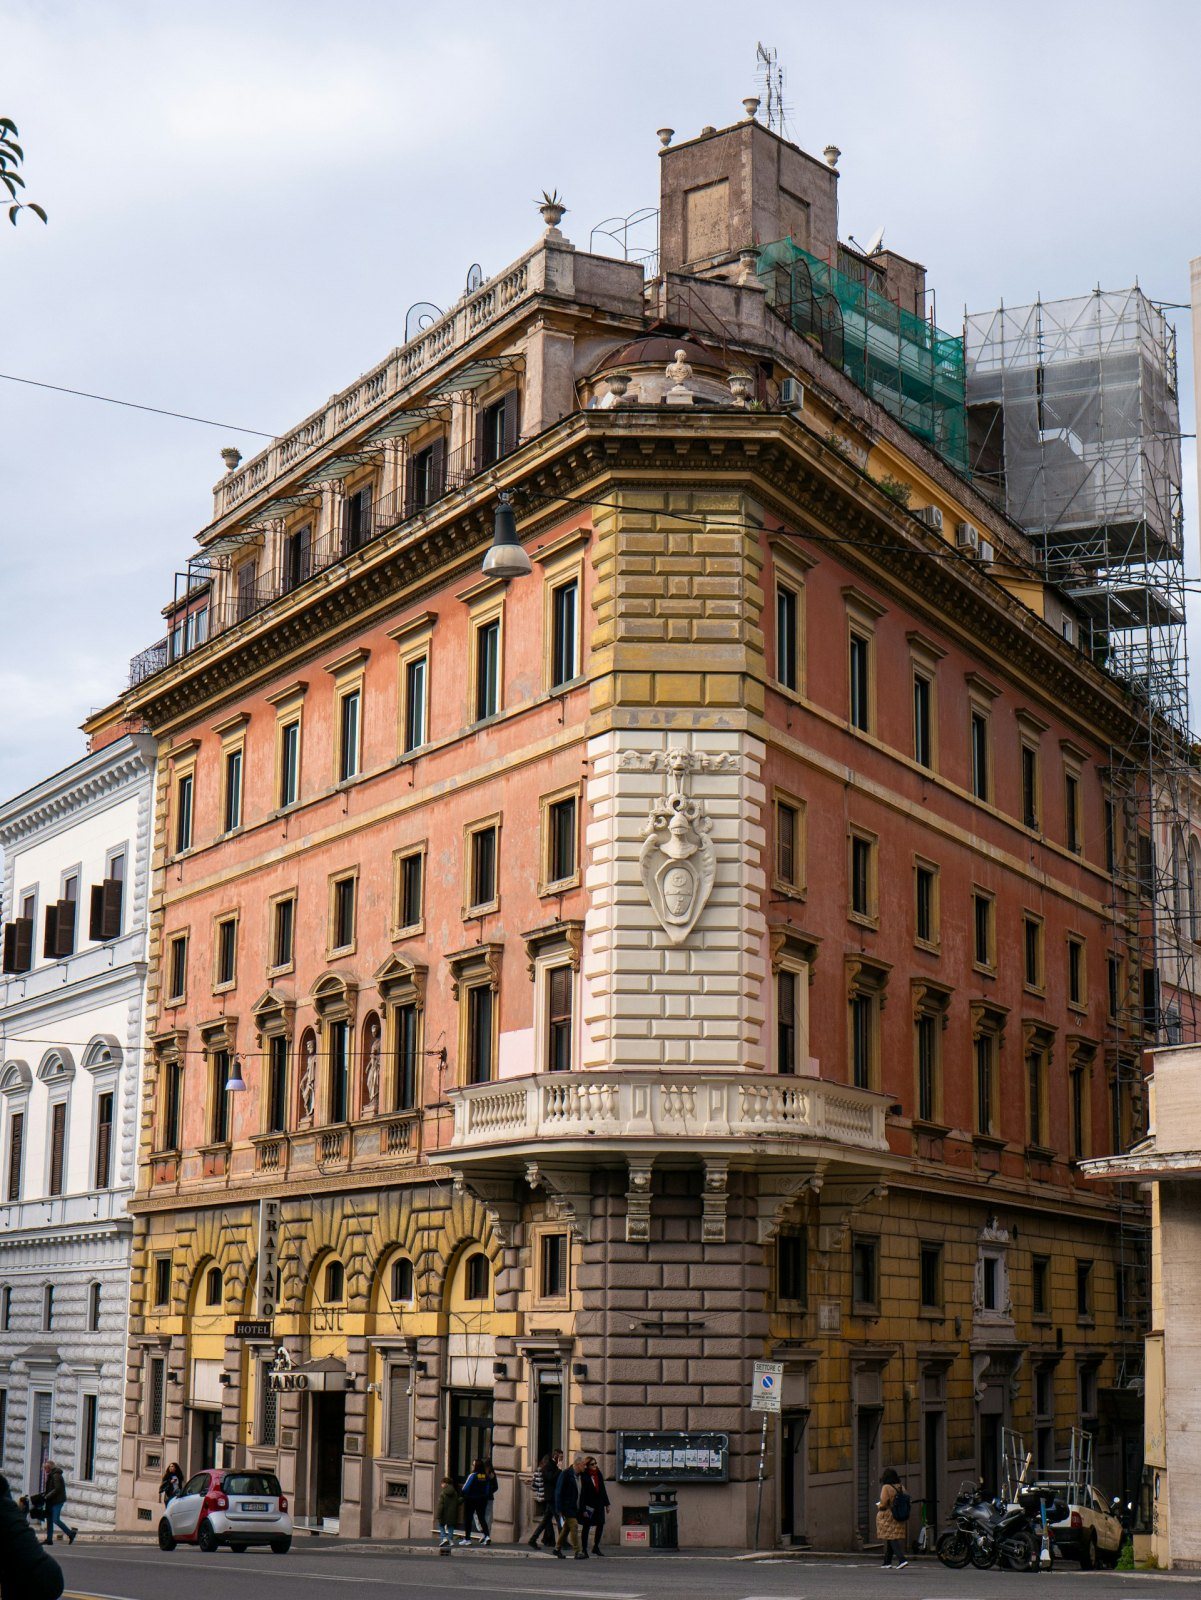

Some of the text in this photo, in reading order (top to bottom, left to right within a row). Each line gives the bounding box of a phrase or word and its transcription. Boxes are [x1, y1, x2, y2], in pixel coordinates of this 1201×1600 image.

[262, 1203, 277, 1317] TRAIANO
[237, 1325, 269, 1335] HOTEL
[756, 1363, 776, 1372] SETTORE
